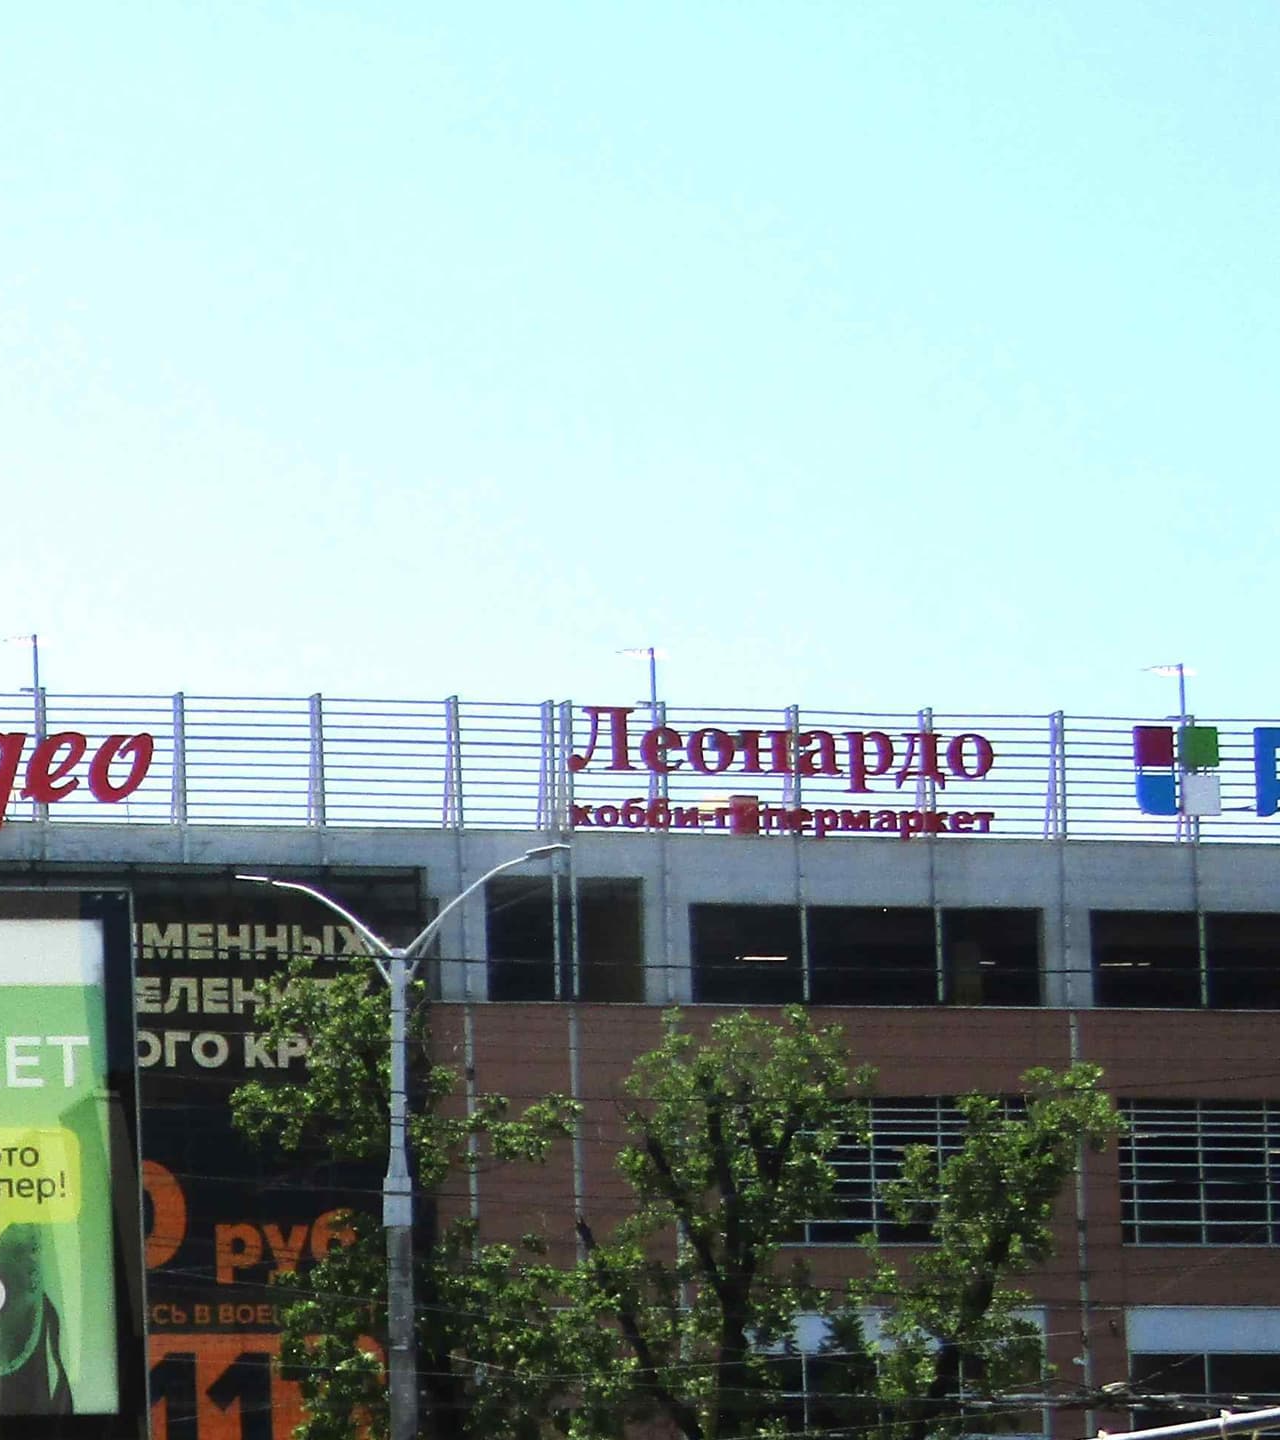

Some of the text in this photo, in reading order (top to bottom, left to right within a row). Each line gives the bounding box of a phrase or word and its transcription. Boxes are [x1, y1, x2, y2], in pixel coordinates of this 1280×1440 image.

[567, 706, 994, 793] Леонардо
[571, 797, 995, 840] хобби-гпермаркет
[134, 922, 366, 960] МЕННЫХ
